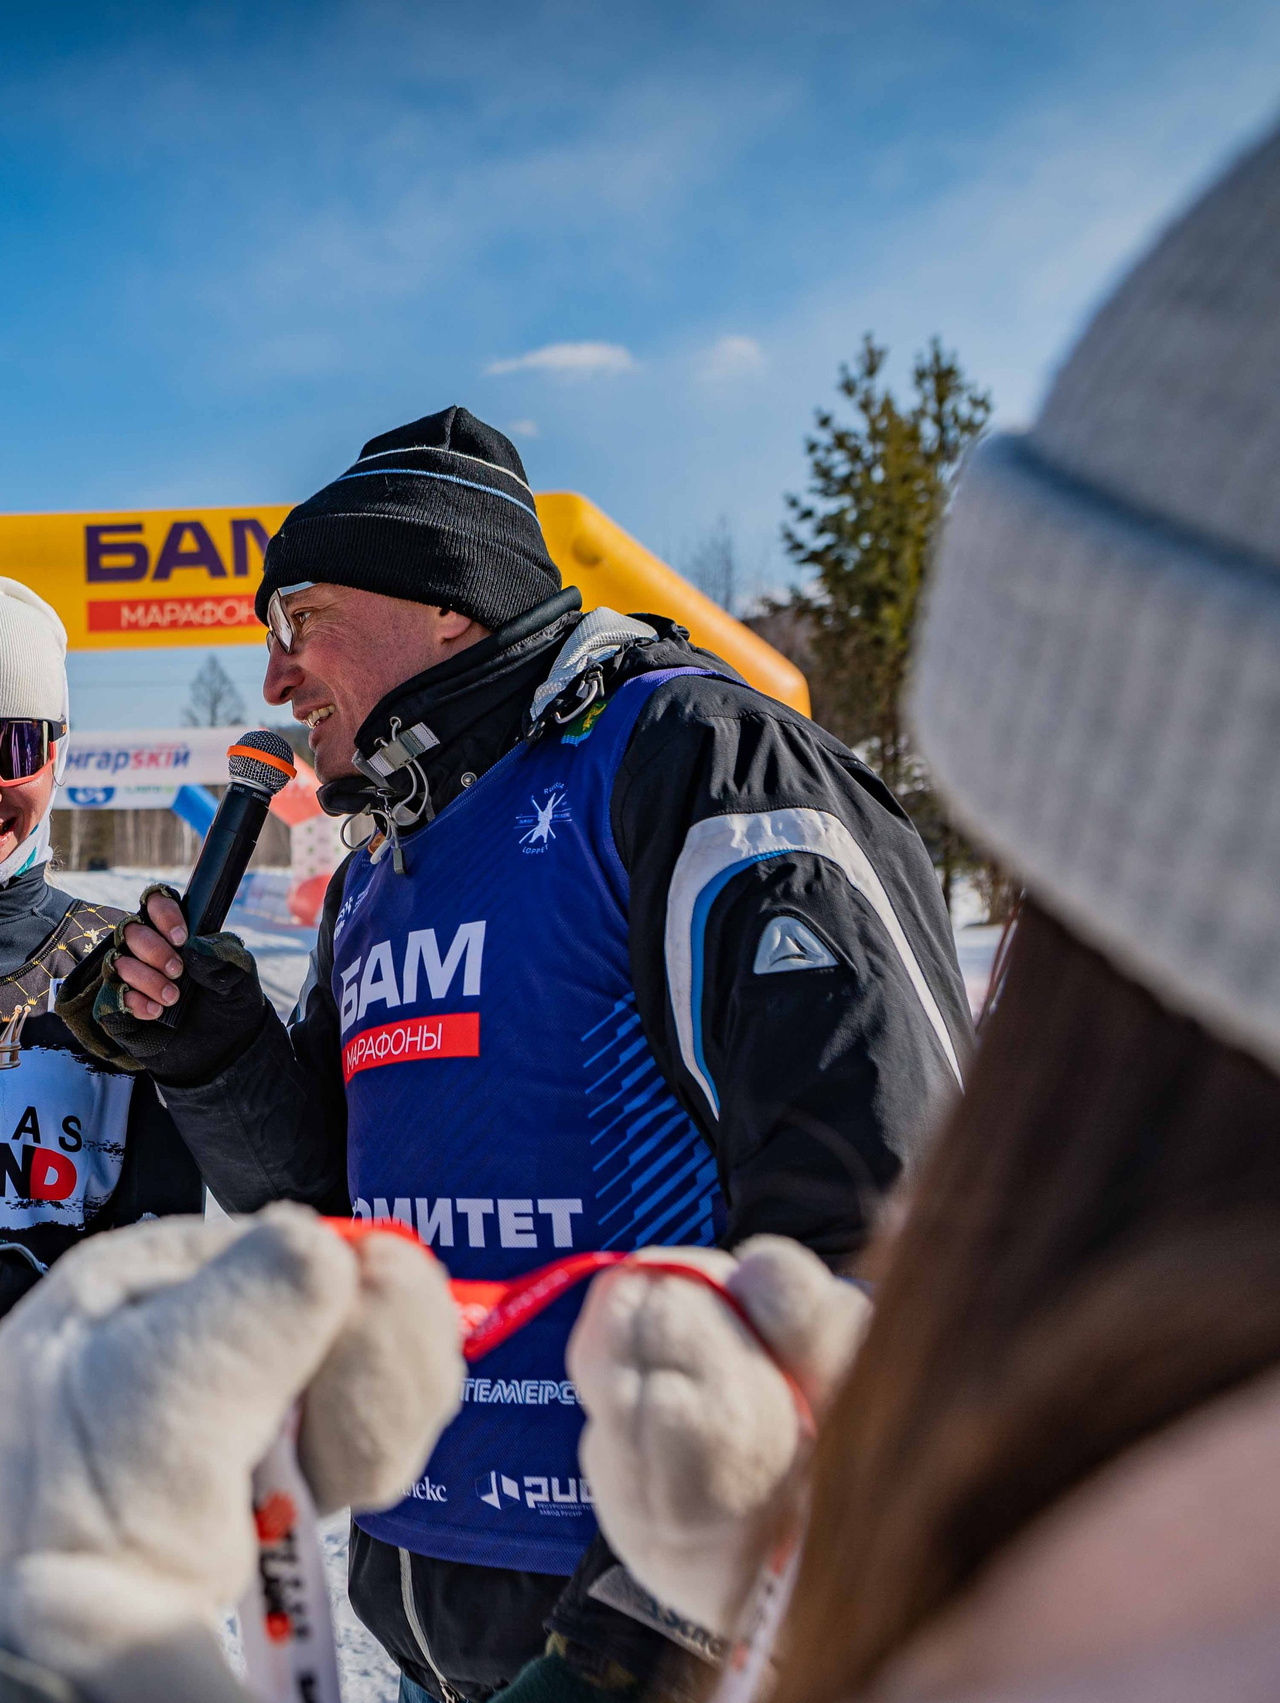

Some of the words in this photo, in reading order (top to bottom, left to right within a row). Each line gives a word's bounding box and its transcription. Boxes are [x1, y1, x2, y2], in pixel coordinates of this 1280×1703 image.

[522, 844, 549, 854] LOPPET
[341, 920, 486, 1037] БАМ
[346, 1023, 442, 1074] МАРАФОНЫ
